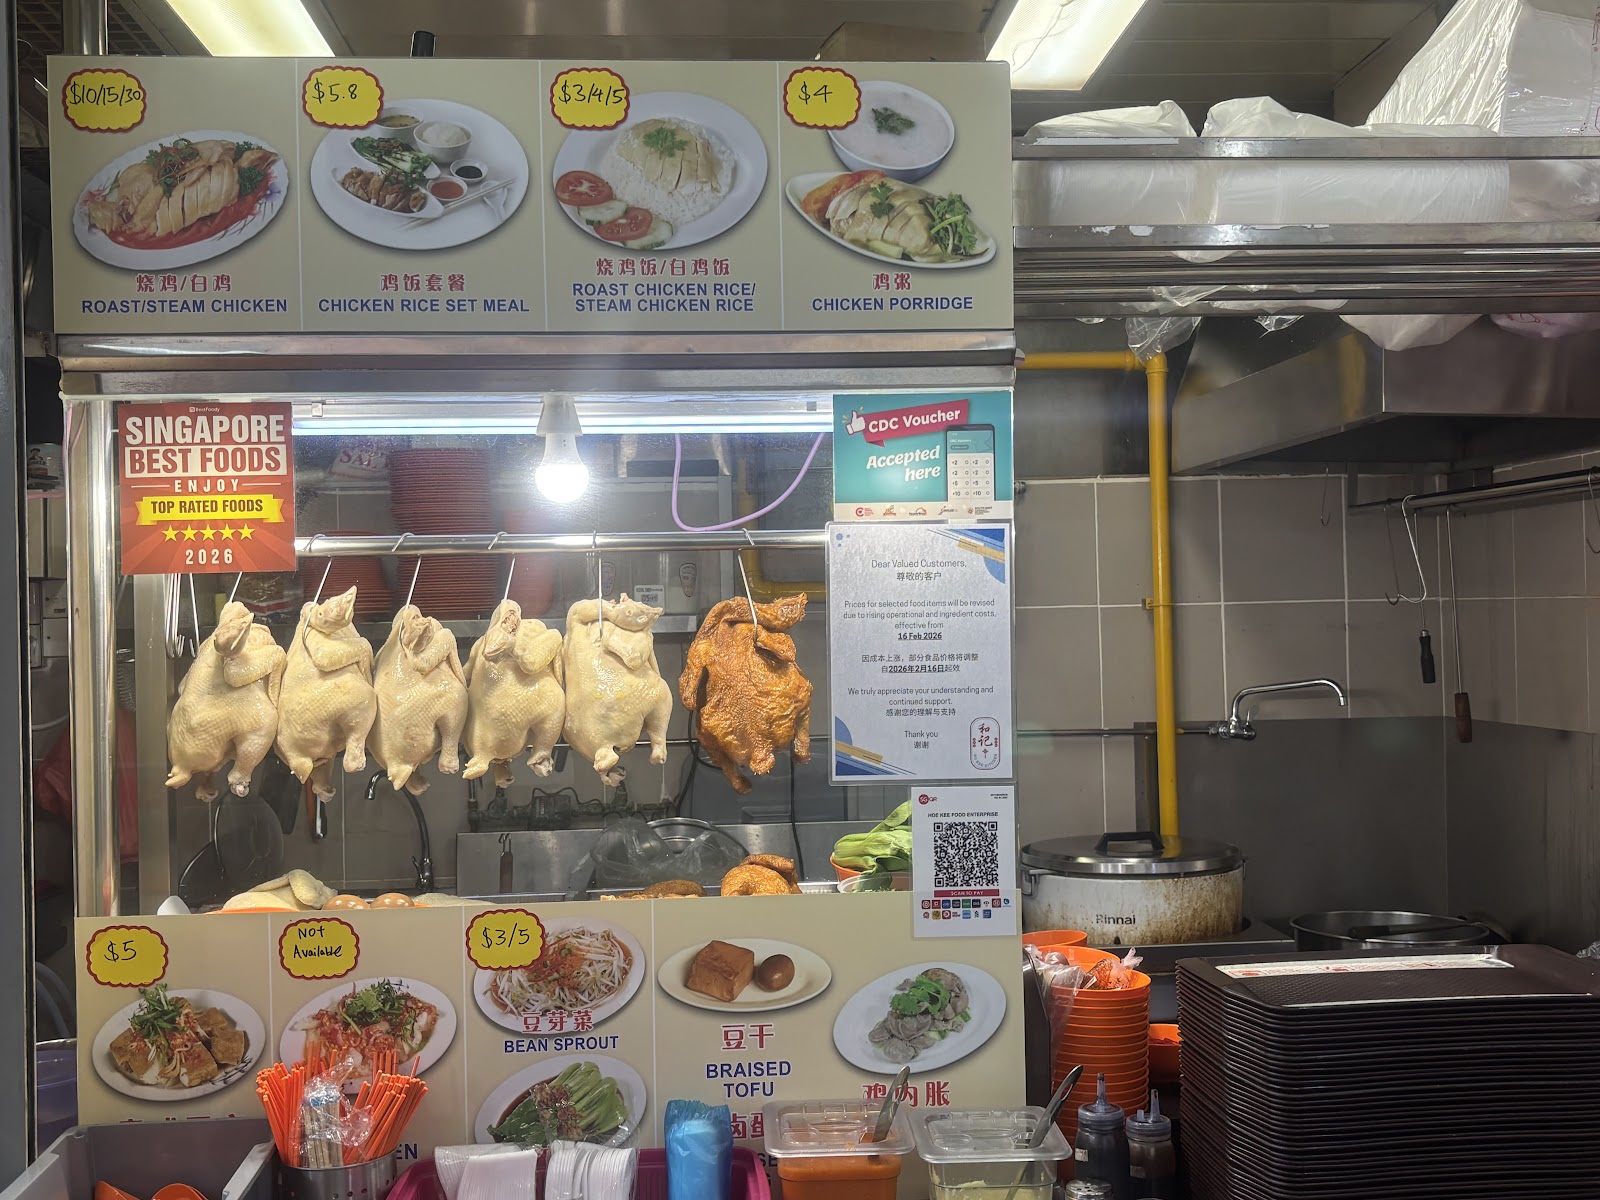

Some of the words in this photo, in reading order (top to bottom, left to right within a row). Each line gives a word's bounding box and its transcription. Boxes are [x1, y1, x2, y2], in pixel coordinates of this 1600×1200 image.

[70, 79, 141, 105] $10/15/30
[312, 78, 358, 103] $5.8
[559, 80, 624, 105] $3/4/5
[798, 78, 833, 104] $4
[596, 258, 731, 276] 烧鸡饭/白鸡饭
[135, 273, 232, 292] 烧鸡/白鸡
[380, 273, 466, 291] 鸡饭套餐
[572, 283, 629, 296] ROAST
[634, 283, 708, 296] CHICKEN
[713, 282, 756, 296] RICE/
[872, 272, 912, 291] 鸡粥
[81, 300, 205, 313] ROAST/STEAM
[211, 299, 287, 312] CHICKEN
[318, 299, 394, 312] CHICKEN
[400, 299, 440, 312] RICE
[445, 299, 477, 312] SET
[483, 299, 529, 312] MEAL
[575, 298, 632, 312] STEAM
[637, 298, 710, 312] CHICKEN
[716, 298, 754, 311] RICE
[812, 298, 884, 311] CHICKEN
[889, 297, 973, 310] PORRIDGE
[869, 418, 899, 433] CDC
[902, 409, 961, 428] Voucher
[125, 415, 285, 445] SINGAPORE
[129, 448, 191, 474] BEST
[201, 447, 281, 473] FOODS
[866, 445, 941, 469] Accepted
[904, 466, 941, 481] here
[174, 479, 239, 492] ENJOY
[151, 501, 175, 514] TOP
[179, 500, 218, 513] RATED
[222, 499, 263, 512] FOODS
[185, 549, 233, 564] 2026
[872, 560, 890, 568] Dear
[892, 559, 918, 568] Valued
[920, 559, 967, 568] Customers,
[896, 572, 942, 581] 尊敬的客户
[844, 600, 866, 608] Prices
[866, 611, 885, 619] rising
[886, 611, 925, 619] operational
[939, 610, 973, 619] ingredient
[923, 632, 942, 640] 2026
[860, 688, 876, 696] truly
[877, 688, 914, 697] appreciate
[930, 687, 980, 695] understanding
[981, 686, 994, 694] and
[889, 698, 923, 706] continued
[924, 698, 953, 706] support.
[885, 708, 956, 717] 感谢您的理解与支持
[978, 723, 993, 746] 和记
[913, 741, 929, 749] 谢谢
[1096, 914, 1136, 925] Rinnai
[481, 923, 531, 949] $3/5
[104, 940, 137, 962] $5
[293, 944, 343, 959] Available
[522, 1010, 595, 1033] 豆芽菜
[504, 1040, 548, 1053] BEAN
[553, 1036, 619, 1050] SPROUT
[721, 1024, 774, 1050] 豆干
[706, 1061, 792, 1079] BRAISED
[723, 1082, 774, 1098] TOFU
